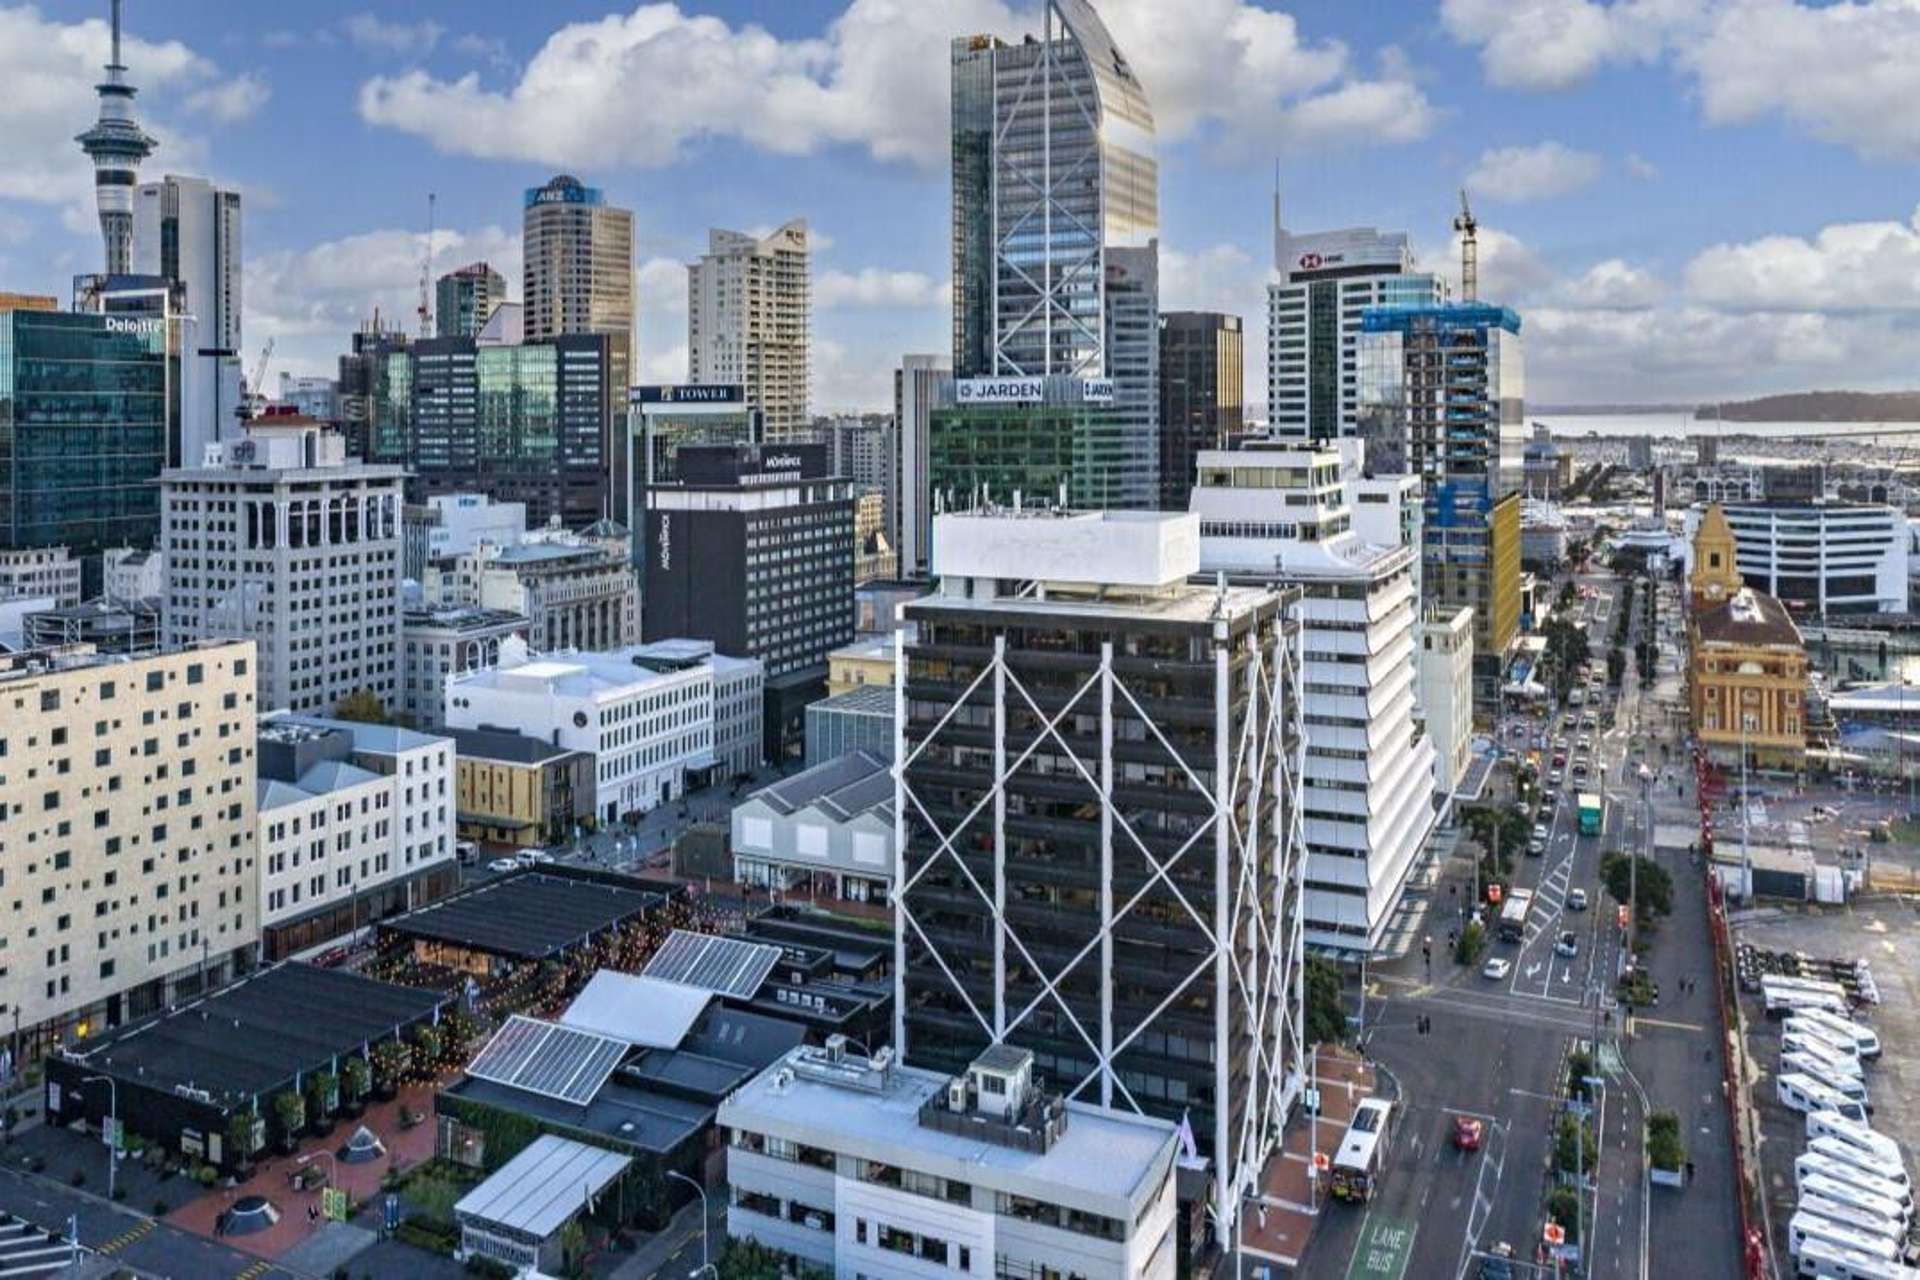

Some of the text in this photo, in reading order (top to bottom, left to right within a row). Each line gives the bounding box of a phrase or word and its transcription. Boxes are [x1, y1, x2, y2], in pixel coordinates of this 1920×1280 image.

[537, 190, 564, 201] ANZ
[105, 317, 161, 332] Deloitte
[976, 383, 1041, 398] JARDEN
[1371, 1226, 1406, 1250] LANE
[1366, 1249, 1394, 1273] BUS
